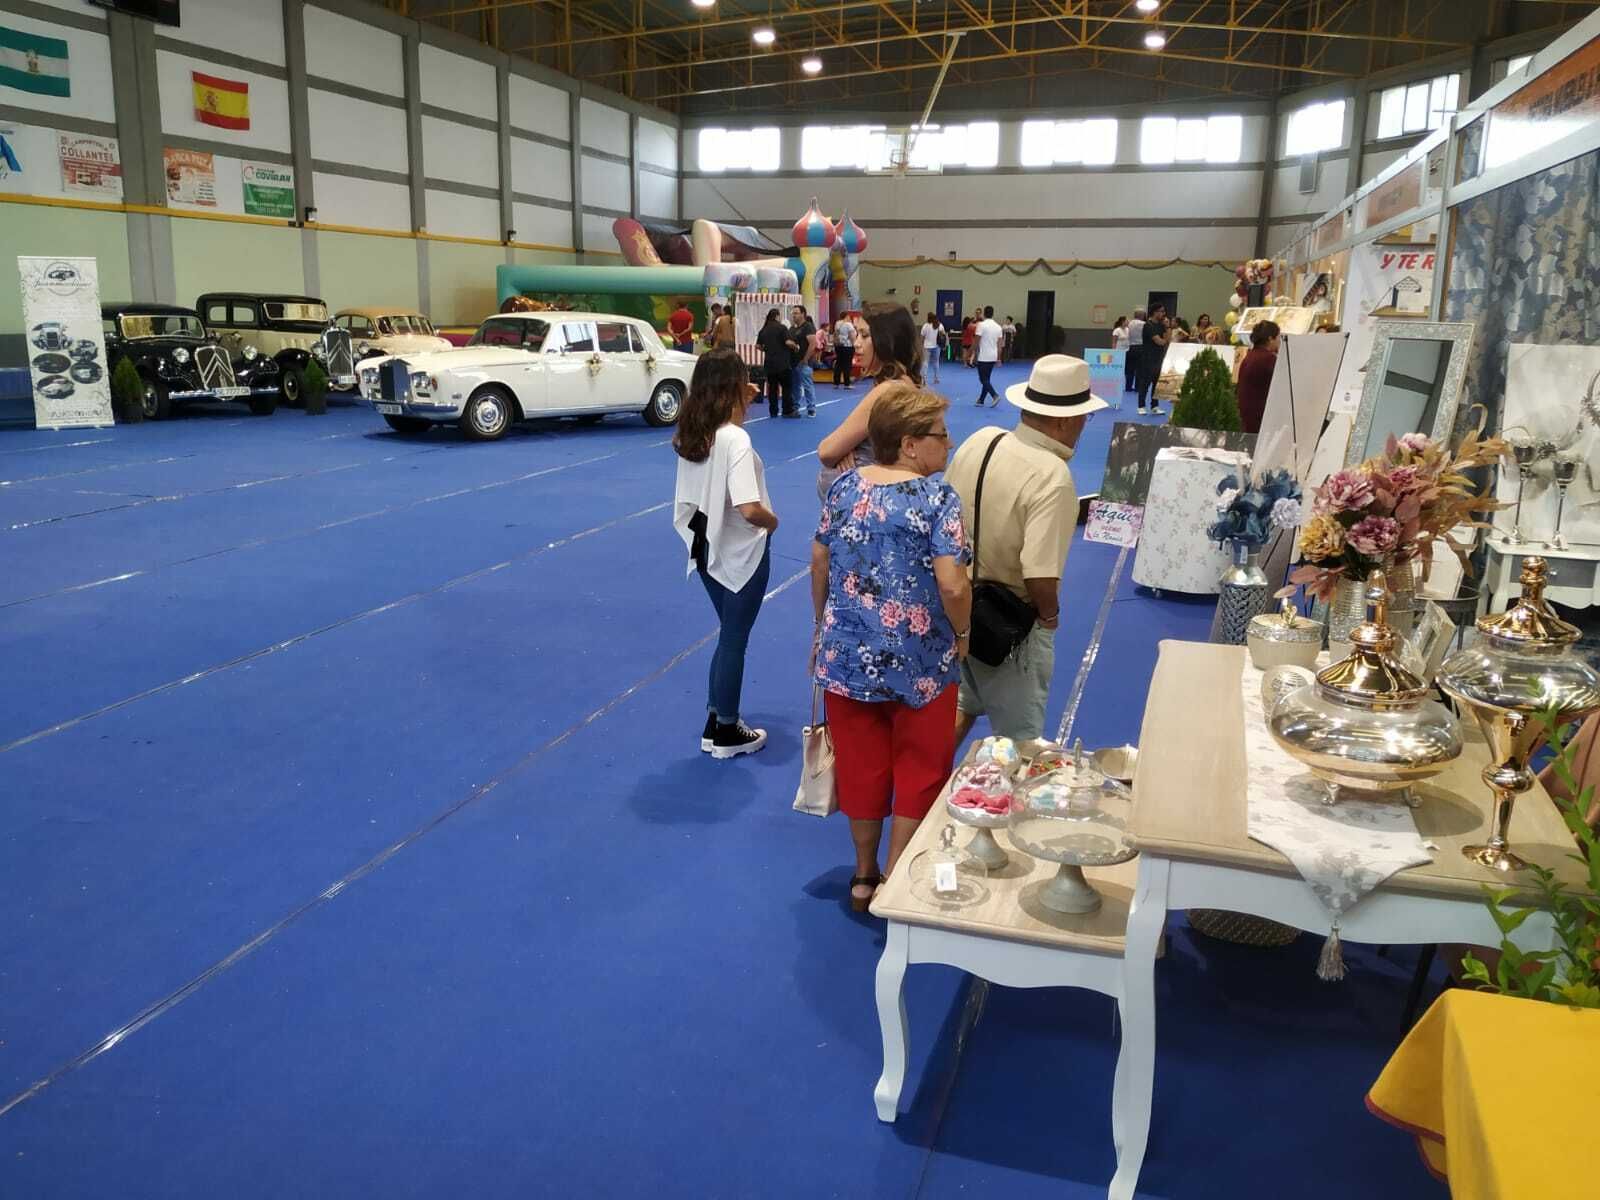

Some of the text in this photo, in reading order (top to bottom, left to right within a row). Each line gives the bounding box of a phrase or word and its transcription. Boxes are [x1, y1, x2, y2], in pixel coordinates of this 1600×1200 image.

[61, 146, 113, 162] COLLANTES
[1380, 254, 1396, 270] Y
[1398, 254, 1420, 270] TE
